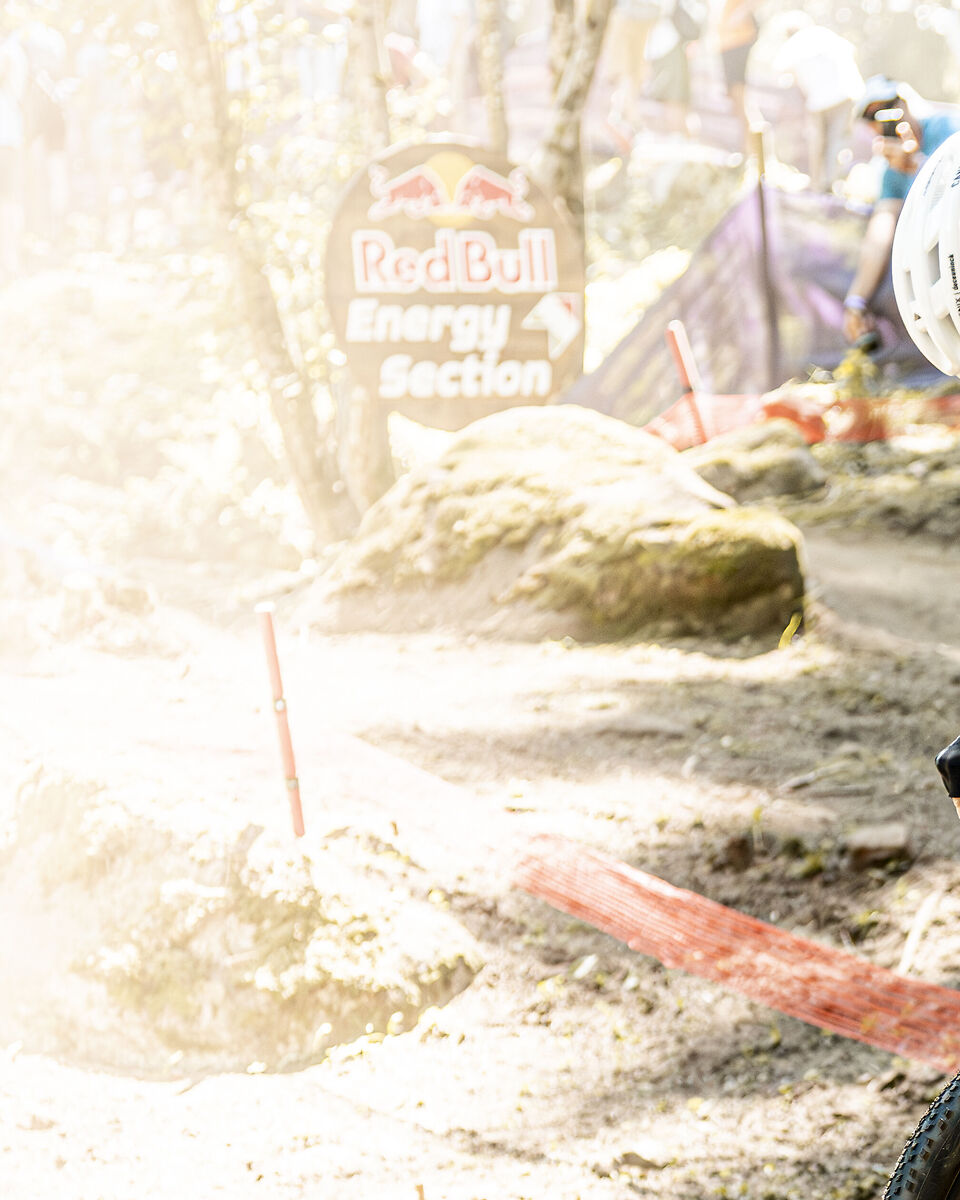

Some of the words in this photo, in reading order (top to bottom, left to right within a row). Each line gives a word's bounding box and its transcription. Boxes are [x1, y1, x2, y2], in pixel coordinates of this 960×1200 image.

[356, 232, 455, 289] Red
[459, 232, 554, 289] Bull
[346, 297, 512, 353] Energy
[379, 352, 552, 398] Section
